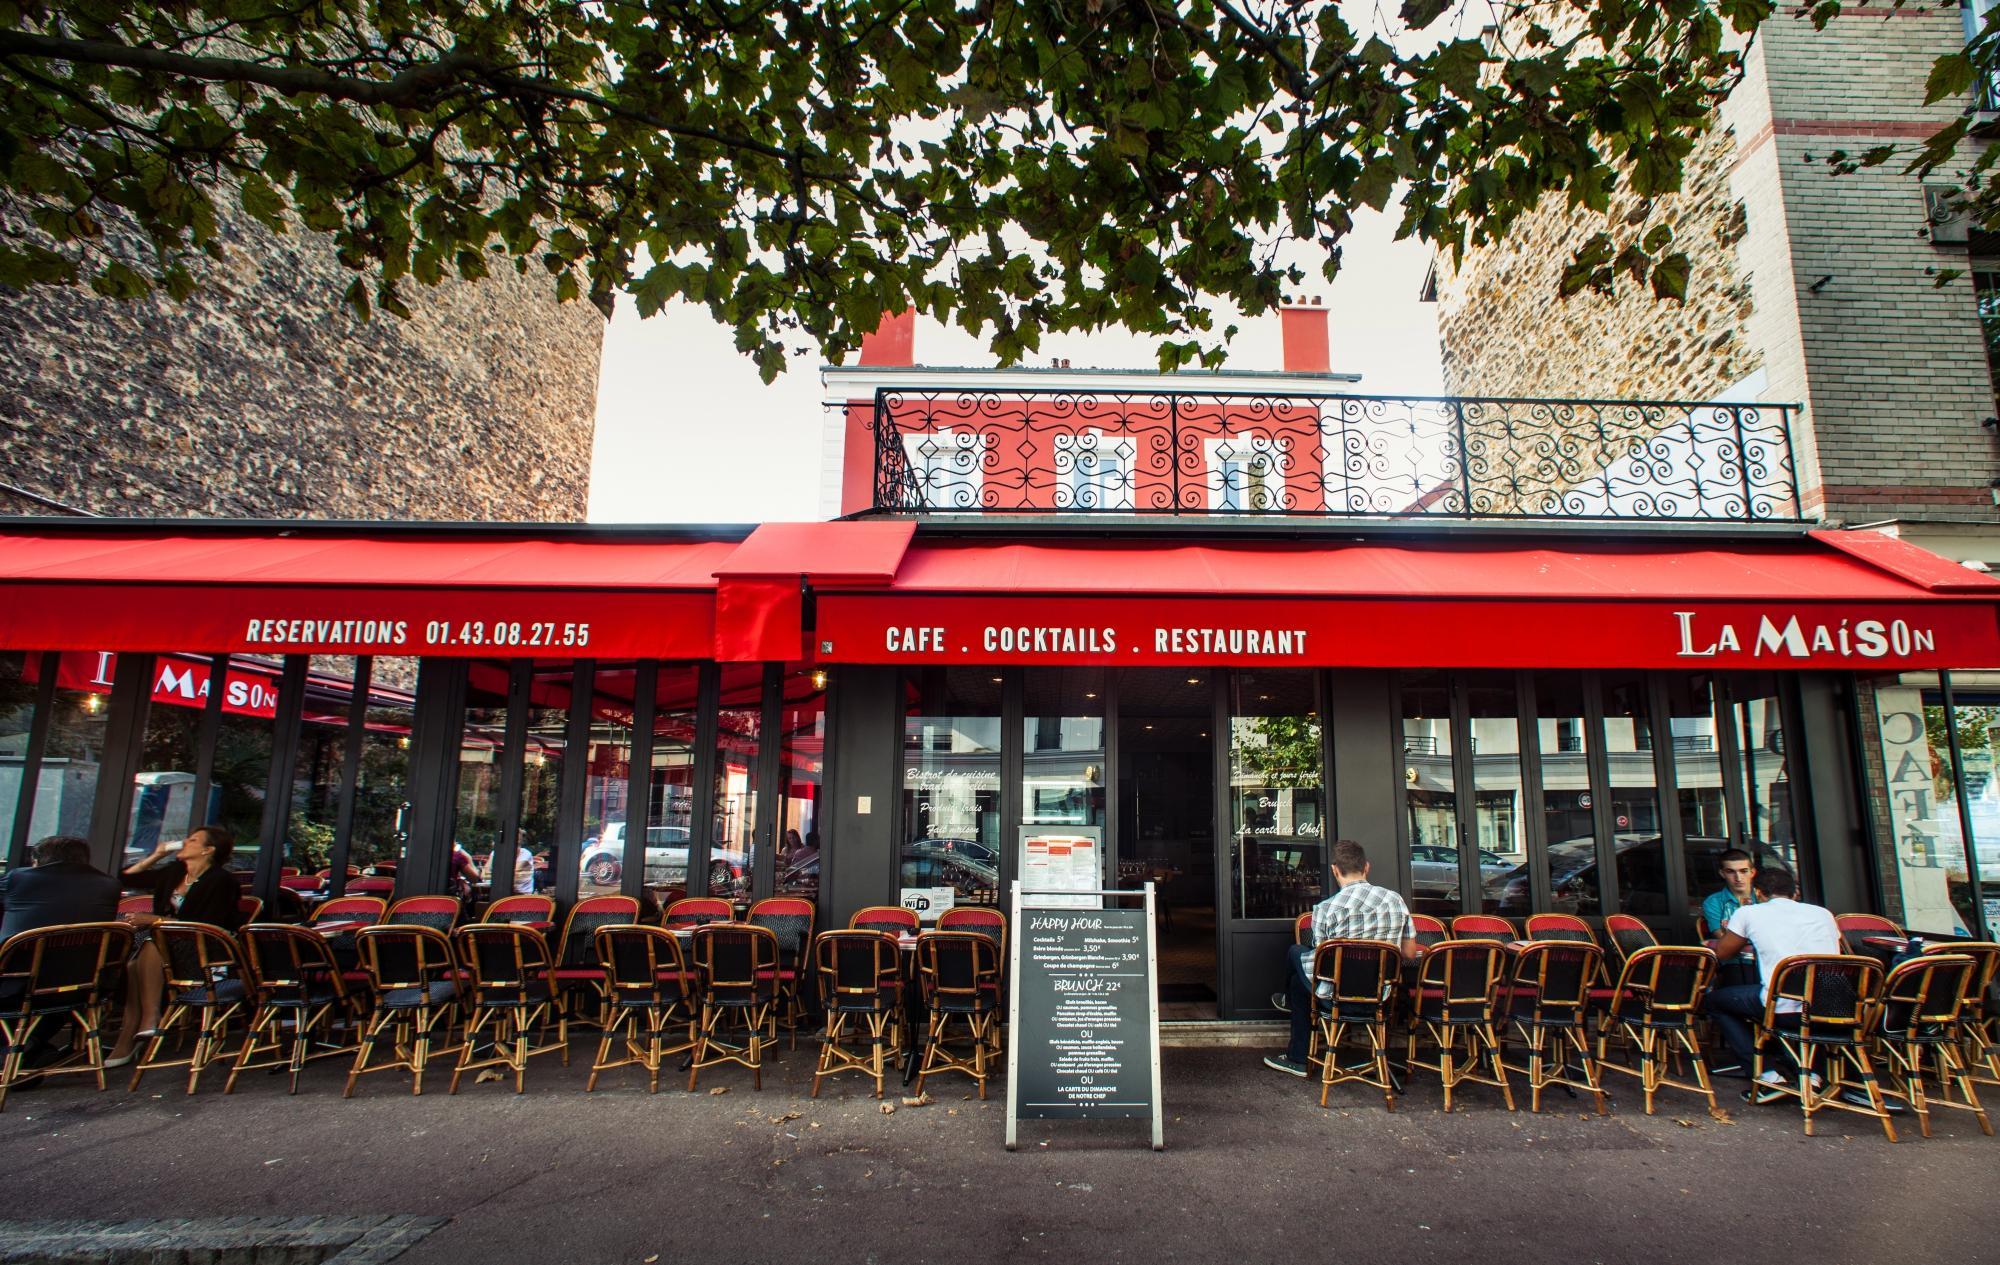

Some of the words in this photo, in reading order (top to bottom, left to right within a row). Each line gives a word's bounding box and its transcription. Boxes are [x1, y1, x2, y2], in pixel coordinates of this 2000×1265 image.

[246, 619, 408, 644] RESERVATIONS
[426, 621, 590, 646] 01.43.08.27.55
[886, 626, 945, 653] CAFE
[983, 626, 1117, 654] COCKTAILS
[1154, 628, 1307, 655] RESTAURANT
[906, 768, 944, 779] Bistrot
[945, 769, 958, 779] de
[961, 769, 996, 779] cuisine
[1258, 797, 1293, 807] Brunch
[1236, 824, 1252, 834] La
[1254, 826, 1279, 834] carte
[1297, 822, 1321, 836] Chef
[1030, 917, 1069, 932] HAPPY
[1070, 917, 1102, 930] HOUR
[1053, 979, 1104, 992] BRUNCH
[1080, 1030, 1093, 1038] OU
[1080, 1075, 1094, 1084] OU
